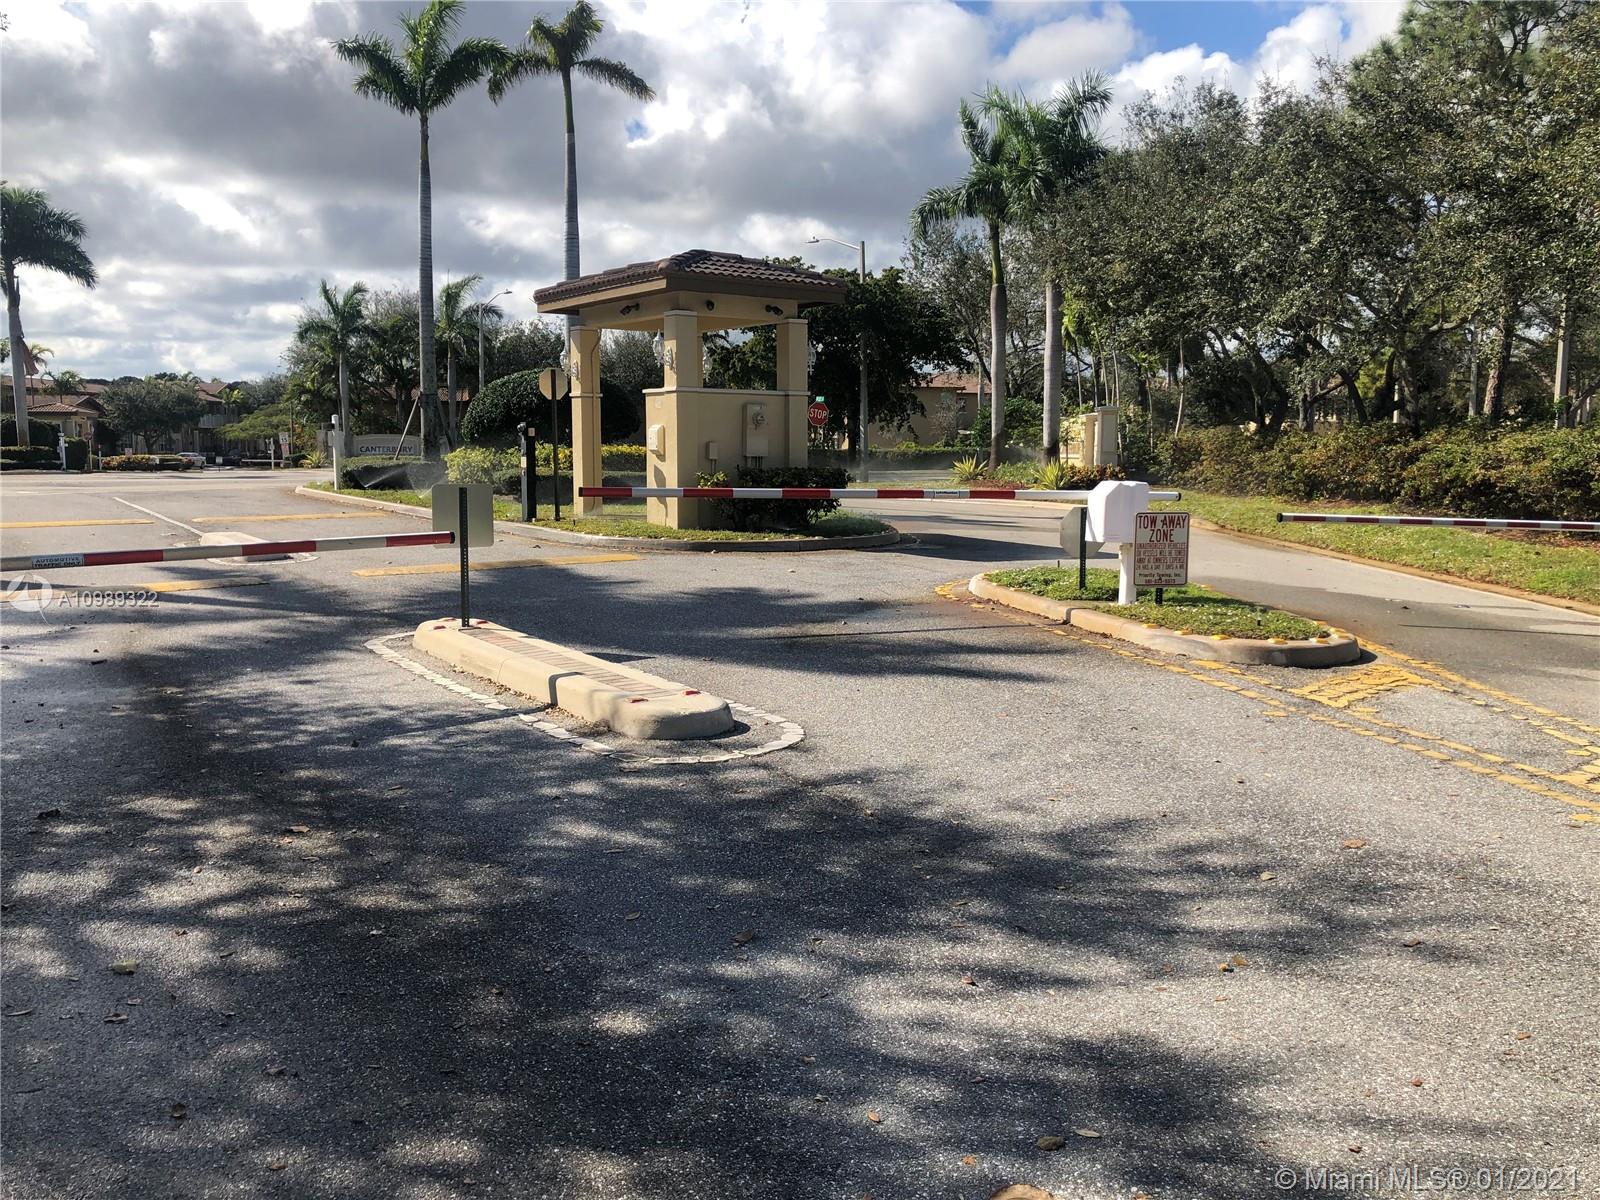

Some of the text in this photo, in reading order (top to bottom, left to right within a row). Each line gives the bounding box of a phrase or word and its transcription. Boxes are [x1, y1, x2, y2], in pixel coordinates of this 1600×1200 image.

[810, 408, 827, 419] STOP
[360, 445, 412, 453] CANTERBRY
[1138, 515, 1187, 529] TOW AWAY
[1149, 529, 1174, 542] ZONE
